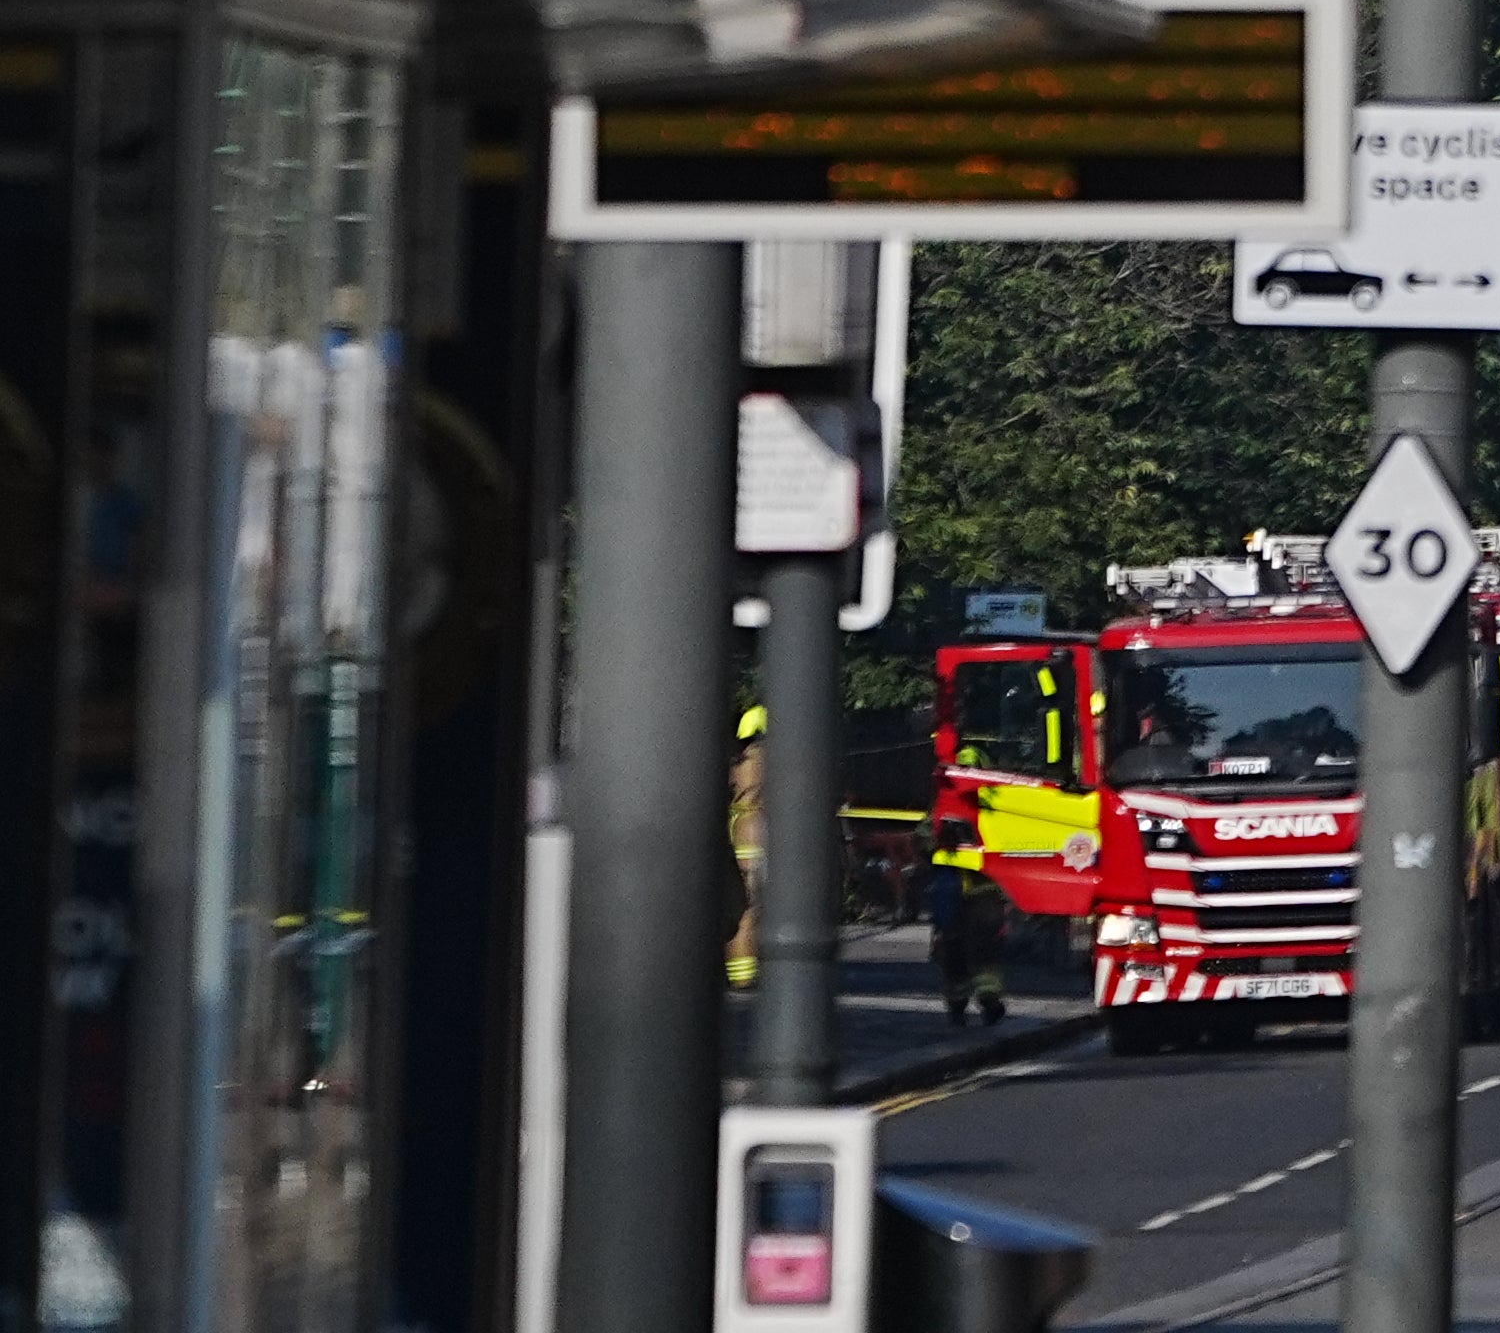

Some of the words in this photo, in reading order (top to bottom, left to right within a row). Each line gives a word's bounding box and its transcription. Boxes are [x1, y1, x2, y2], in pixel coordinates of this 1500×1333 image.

[1370, 178, 1480, 205] space
[1360, 529, 1447, 578] 30
[1213, 814, 1340, 841] SCANIA
